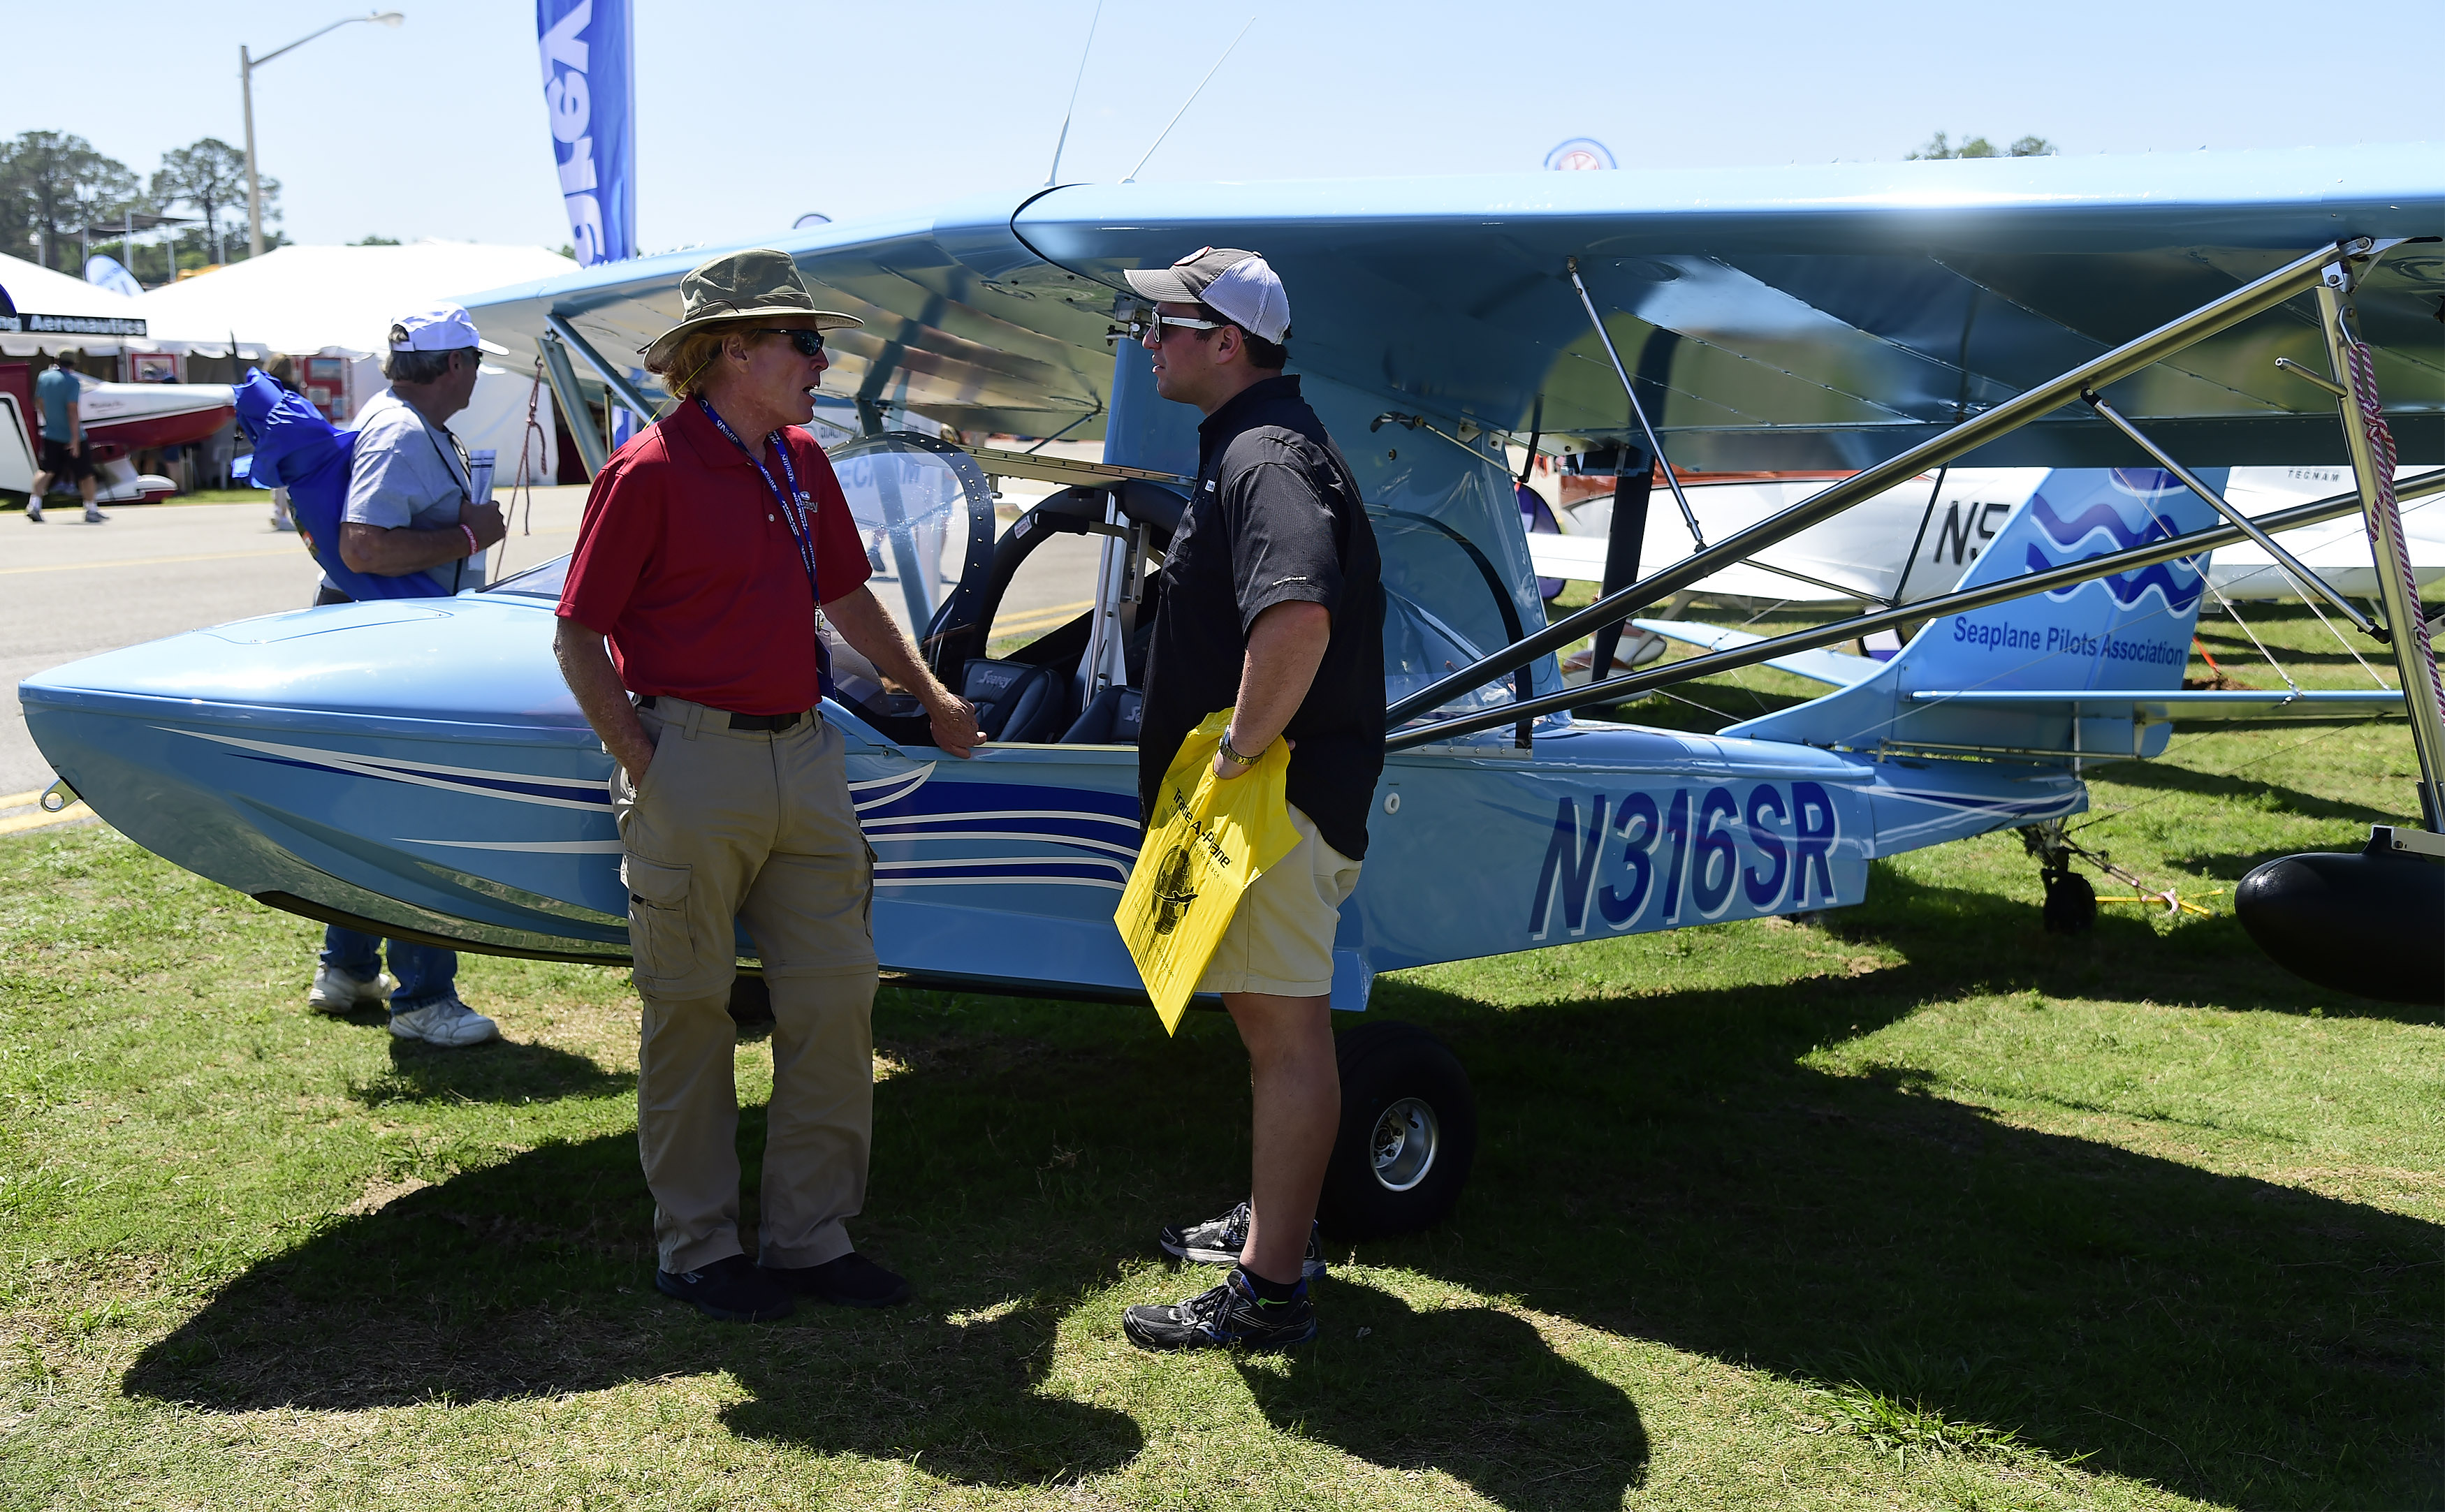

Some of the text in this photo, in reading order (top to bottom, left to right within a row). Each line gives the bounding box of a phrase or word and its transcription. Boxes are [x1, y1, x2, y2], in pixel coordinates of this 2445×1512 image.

[29, 314, 146, 335] Aeronautics
[2288, 469, 2340, 483] TECNAM
[1953, 616, 2183, 666] Seaplane Pilots Association
[977, 670, 1012, 689] Searey
[1528, 781, 1840, 941] N316SR
